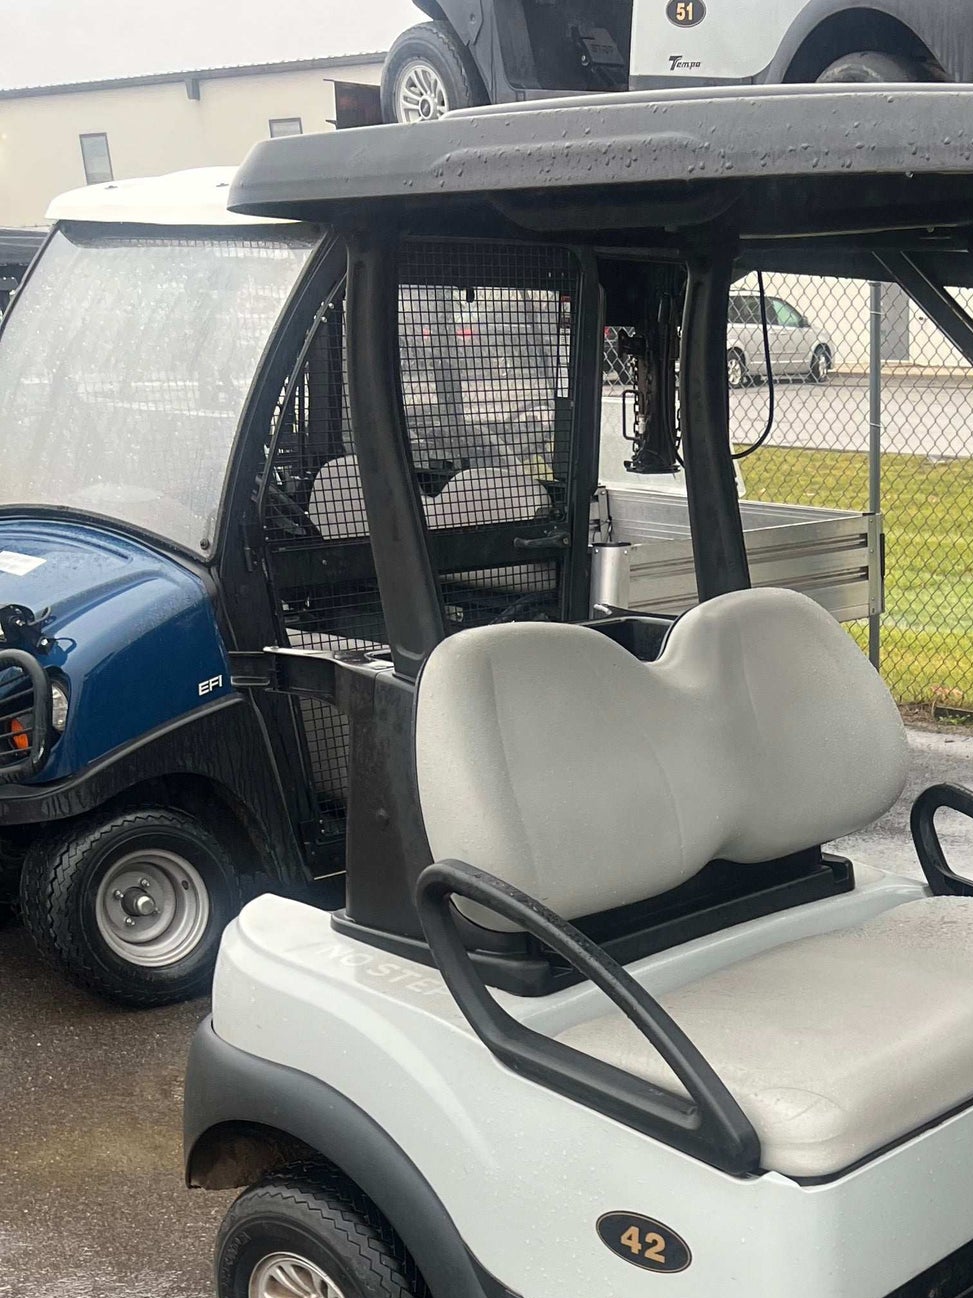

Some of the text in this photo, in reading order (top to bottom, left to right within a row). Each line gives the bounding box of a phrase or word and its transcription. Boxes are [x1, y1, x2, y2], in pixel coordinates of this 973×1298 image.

[676, 2, 693, 20] 51
[669, 55, 701, 71] Tempo
[198, 674, 222, 696] EFI
[620, 1225, 666, 1263] 42
